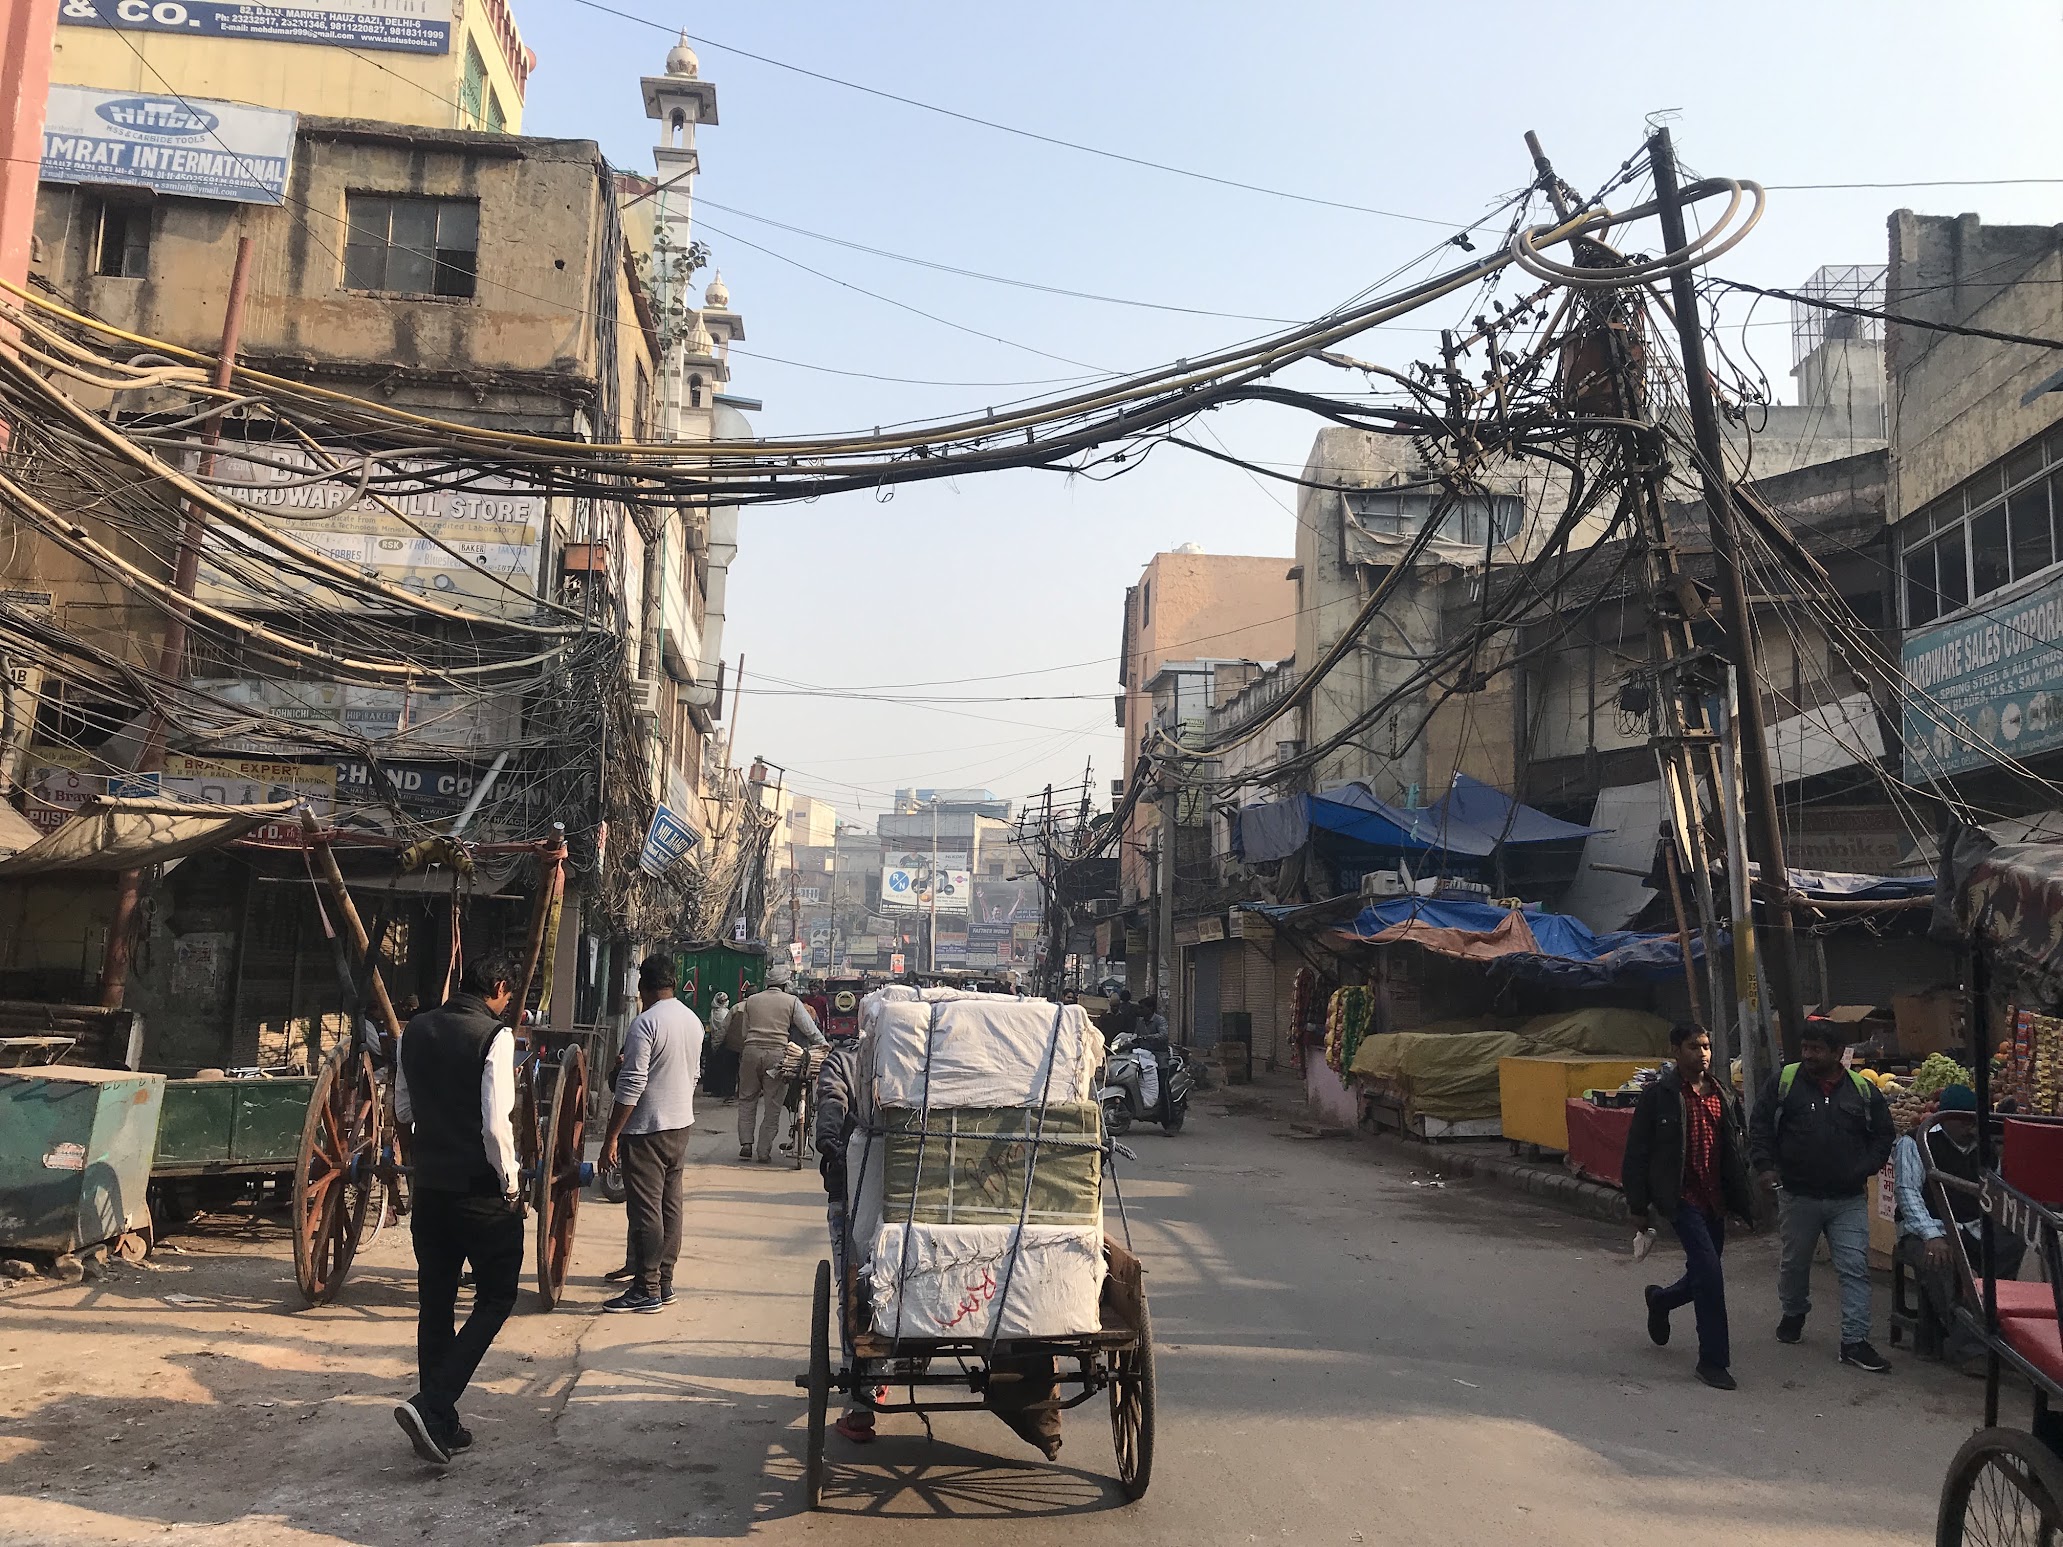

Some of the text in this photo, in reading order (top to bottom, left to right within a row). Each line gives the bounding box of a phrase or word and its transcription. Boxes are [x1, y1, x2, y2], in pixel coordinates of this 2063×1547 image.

[62, 0, 201, 28] & CO.
[286, 9, 327, 21] MARKET,
[329, 12, 356, 23] HAUZ
[357, 15, 383, 26] QAZI,
[385, 17, 421, 29] DELHI-6
[132, 131, 173, 144] CARBIDE
[175, 135, 206, 145] TOOLS
[131, 144, 283, 183] INTERNATIONAL
[450, 497, 531, 525] STORE
[468, 522, 517, 535] Laboratory
[381, 540, 401, 549] RSK
[460, 543, 486, 554] BAKER
[1905, 638, 1962, 697] HARDWARE
[1964, 622, 2001, 674] SALES
[1940, 681, 1972, 700] SPRING
[1972, 671, 2001, 690] STEEL
[2011, 658, 2030, 677] ALL
[2019, 672, 2044, 690] SAW,
[184, 759, 225, 771] BRAY
[240, 763, 302, 776] EXPERT
[892, 873, 900, 881] R
[899, 882, 906, 890] N
